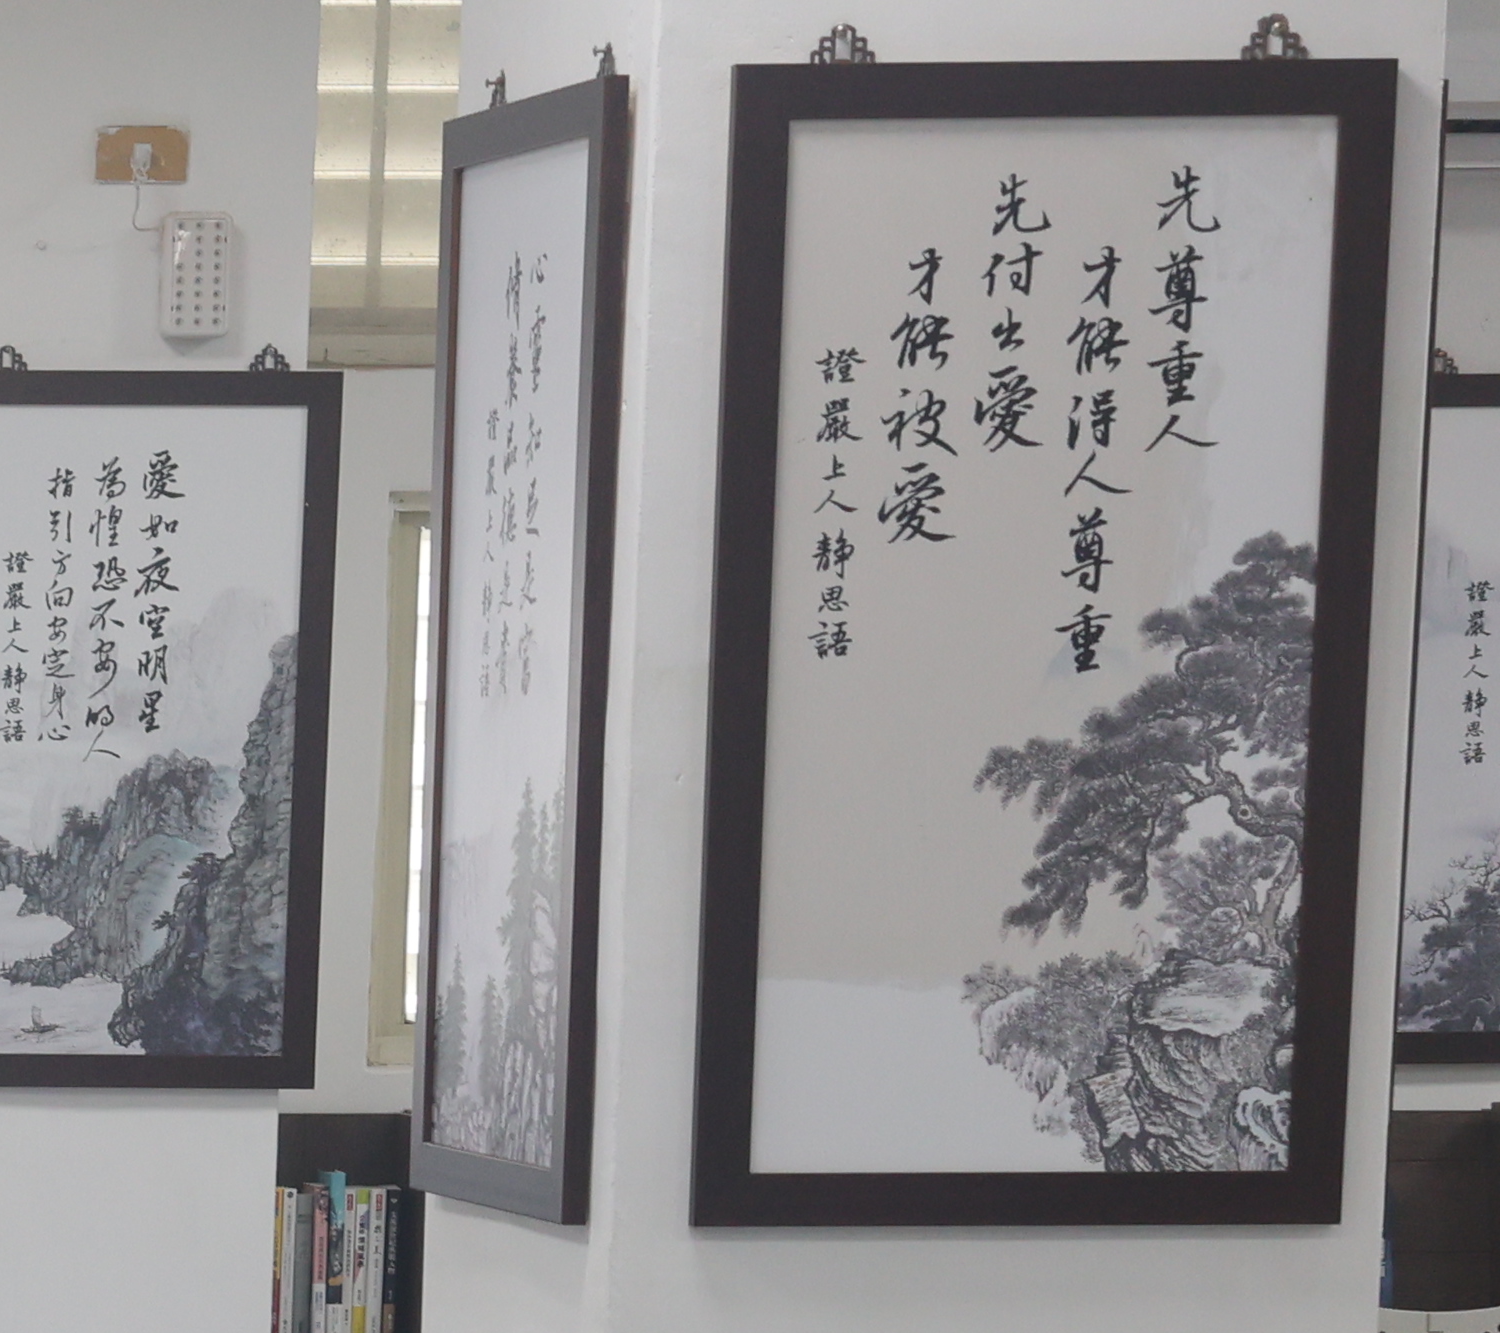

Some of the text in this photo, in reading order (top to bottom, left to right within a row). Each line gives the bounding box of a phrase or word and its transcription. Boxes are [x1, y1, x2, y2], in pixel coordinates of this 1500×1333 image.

[877, 247, 959, 545] 才能被愛
[972, 172, 1048, 453] 先付出愛
[1144, 164, 1222, 453] 先尊重人
[133, 449, 187, 734] 愛如夜空明星
[1055, 245, 1134, 674] 才能得人尊重
[37, 467, 76, 742] 指引方向安定身心
